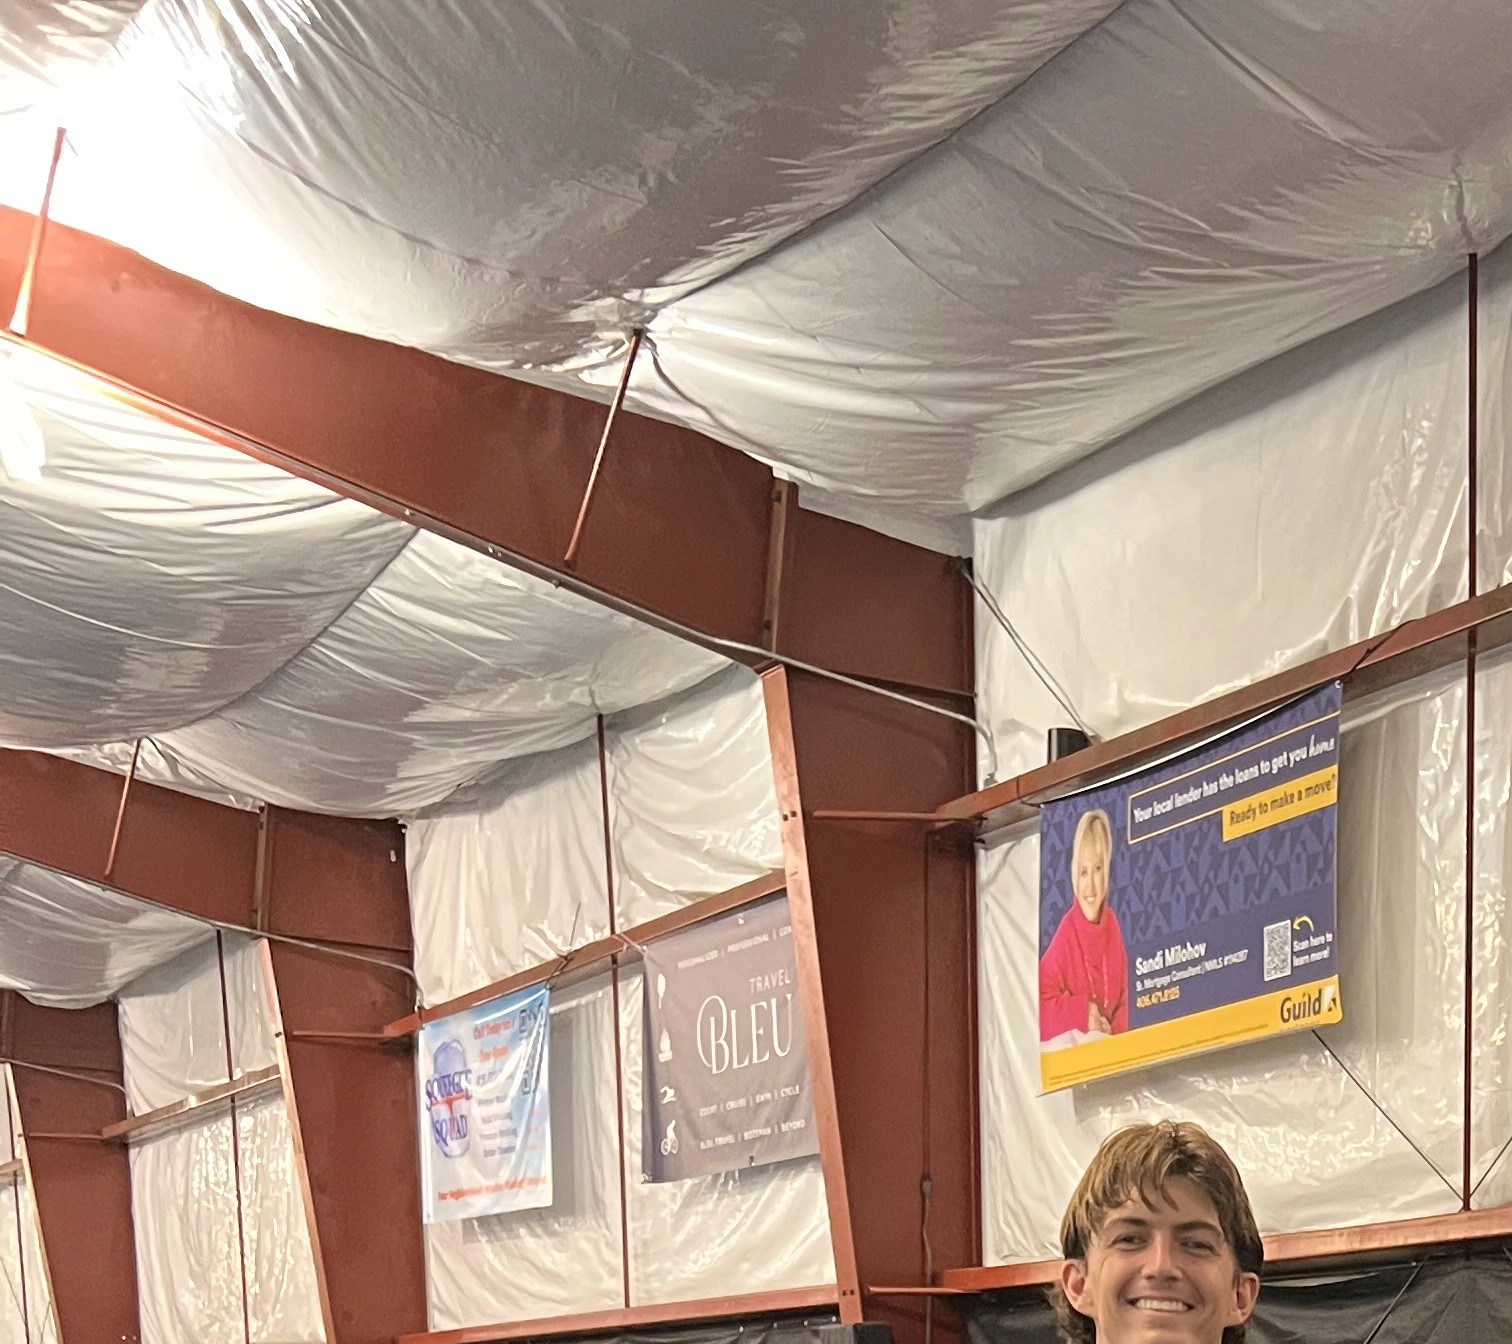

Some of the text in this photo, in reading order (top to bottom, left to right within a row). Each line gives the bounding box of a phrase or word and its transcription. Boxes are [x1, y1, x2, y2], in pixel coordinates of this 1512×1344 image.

[1134, 807, 1153, 823] Your
[1153, 795, 1174, 817] local
[1175, 786, 1202, 808] lender
[1203, 781, 1218, 797] has
[1219, 773, 1234, 790] the
[1235, 768, 1259, 784] loans
[1260, 760, 1270, 775] to
[1271, 751, 1288, 774] get
[1289, 746, 1307, 767] you
[1230, 804, 1257, 826] Ready
[1259, 802, 1269, 815] to
[1270, 791, 1295, 811] make
[1297, 790, 1302, 801] a
[1135, 950, 1164, 976] Sandi
[749, 969, 791, 994] TRAVEL
[1281, 988, 1322, 1024] Guild
[697, 993, 792, 1074] BLEU
